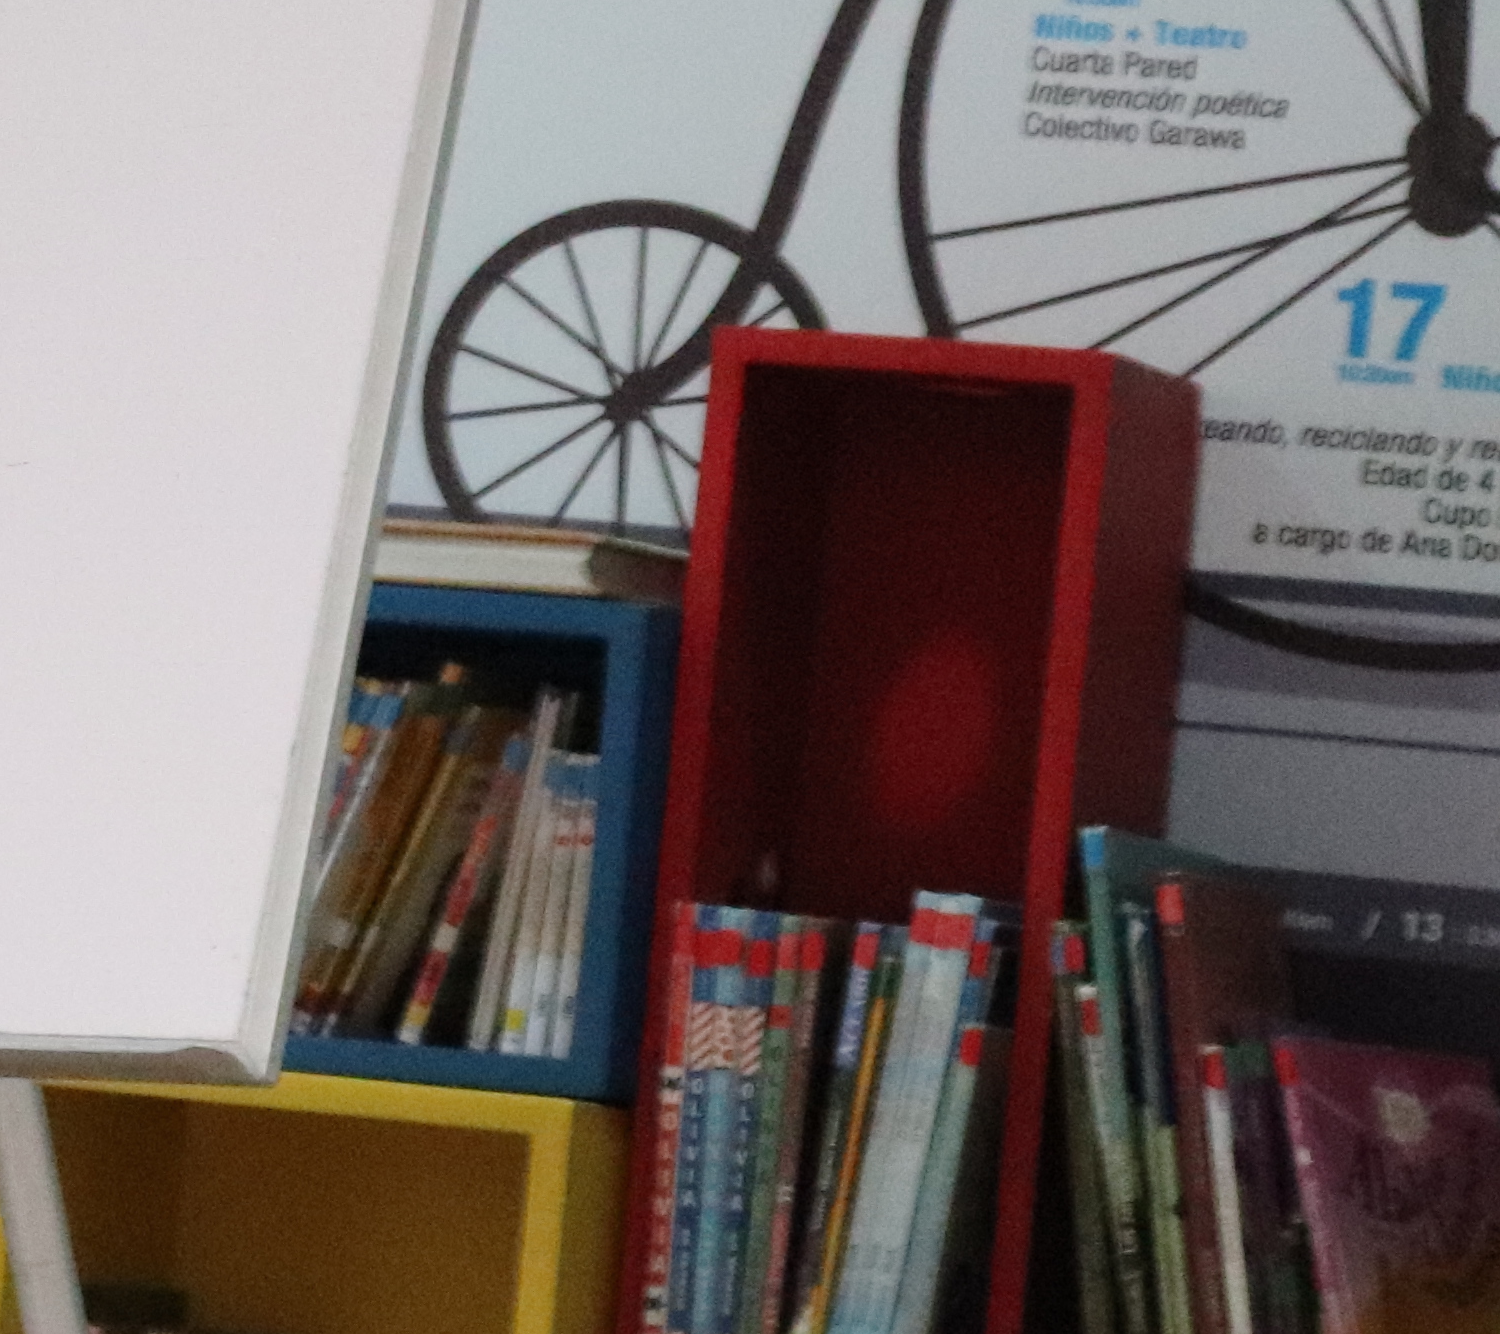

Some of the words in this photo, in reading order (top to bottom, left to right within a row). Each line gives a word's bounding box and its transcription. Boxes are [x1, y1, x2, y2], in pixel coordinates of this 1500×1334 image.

[1033, 14, 1114, 43] Niños
[1155, 19, 1248, 49] Teatro
[1030, 46, 1114, 75] Cuarta
[1123, 51, 1199, 80] Pared
[1026, 80, 1188, 112] Intervención
[1192, 92, 1291, 119] poética
[1023, 110, 1141, 143] Colectivo
[1149, 119, 1247, 150] Garawa
[1338, 277, 1447, 361] 17
[1202, 418, 1288, 449] eando,
[1300, 425, 1440, 457] reciclando
[1441, 437, 1464, 463] y
[1467, 439, 1500, 461] re
[1361, 458, 1429, 489] Edad
[1438, 468, 1470, 492] de
[1479, 468, 1495, 494] 4
[1424, 497, 1493, 529] Cupo
[1252, 523, 1269, 545] a
[1277, 524, 1351, 556] cargo
[1359, 527, 1394, 554] de
[1402, 529, 1452, 559] Ana
[1402, 911, 1444, 943] 13
